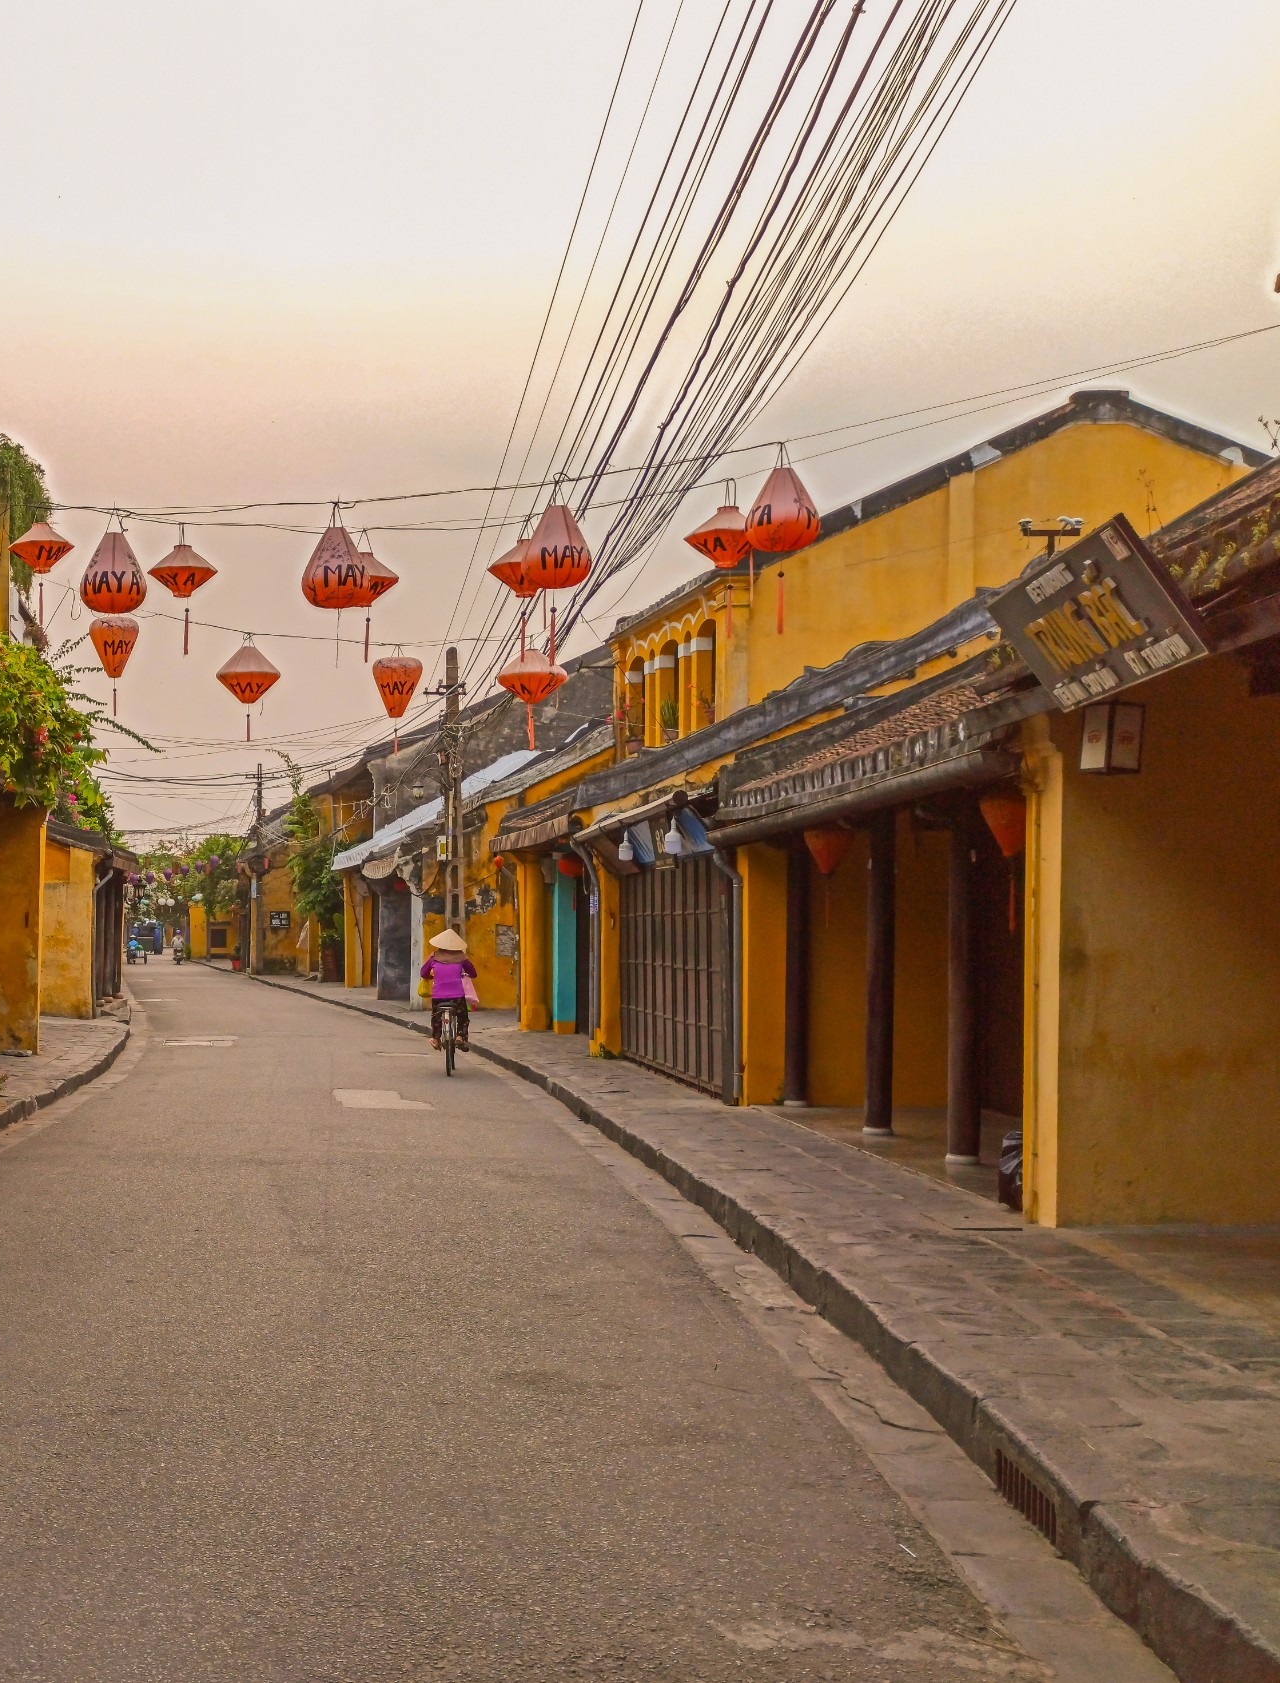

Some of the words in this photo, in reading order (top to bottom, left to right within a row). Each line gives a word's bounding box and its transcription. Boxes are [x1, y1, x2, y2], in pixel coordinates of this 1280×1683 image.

[84, 571, 141, 597] MAYA
[1024, 601, 1108, 672] TRUNG
[381, 681, 414, 696] MAYA
